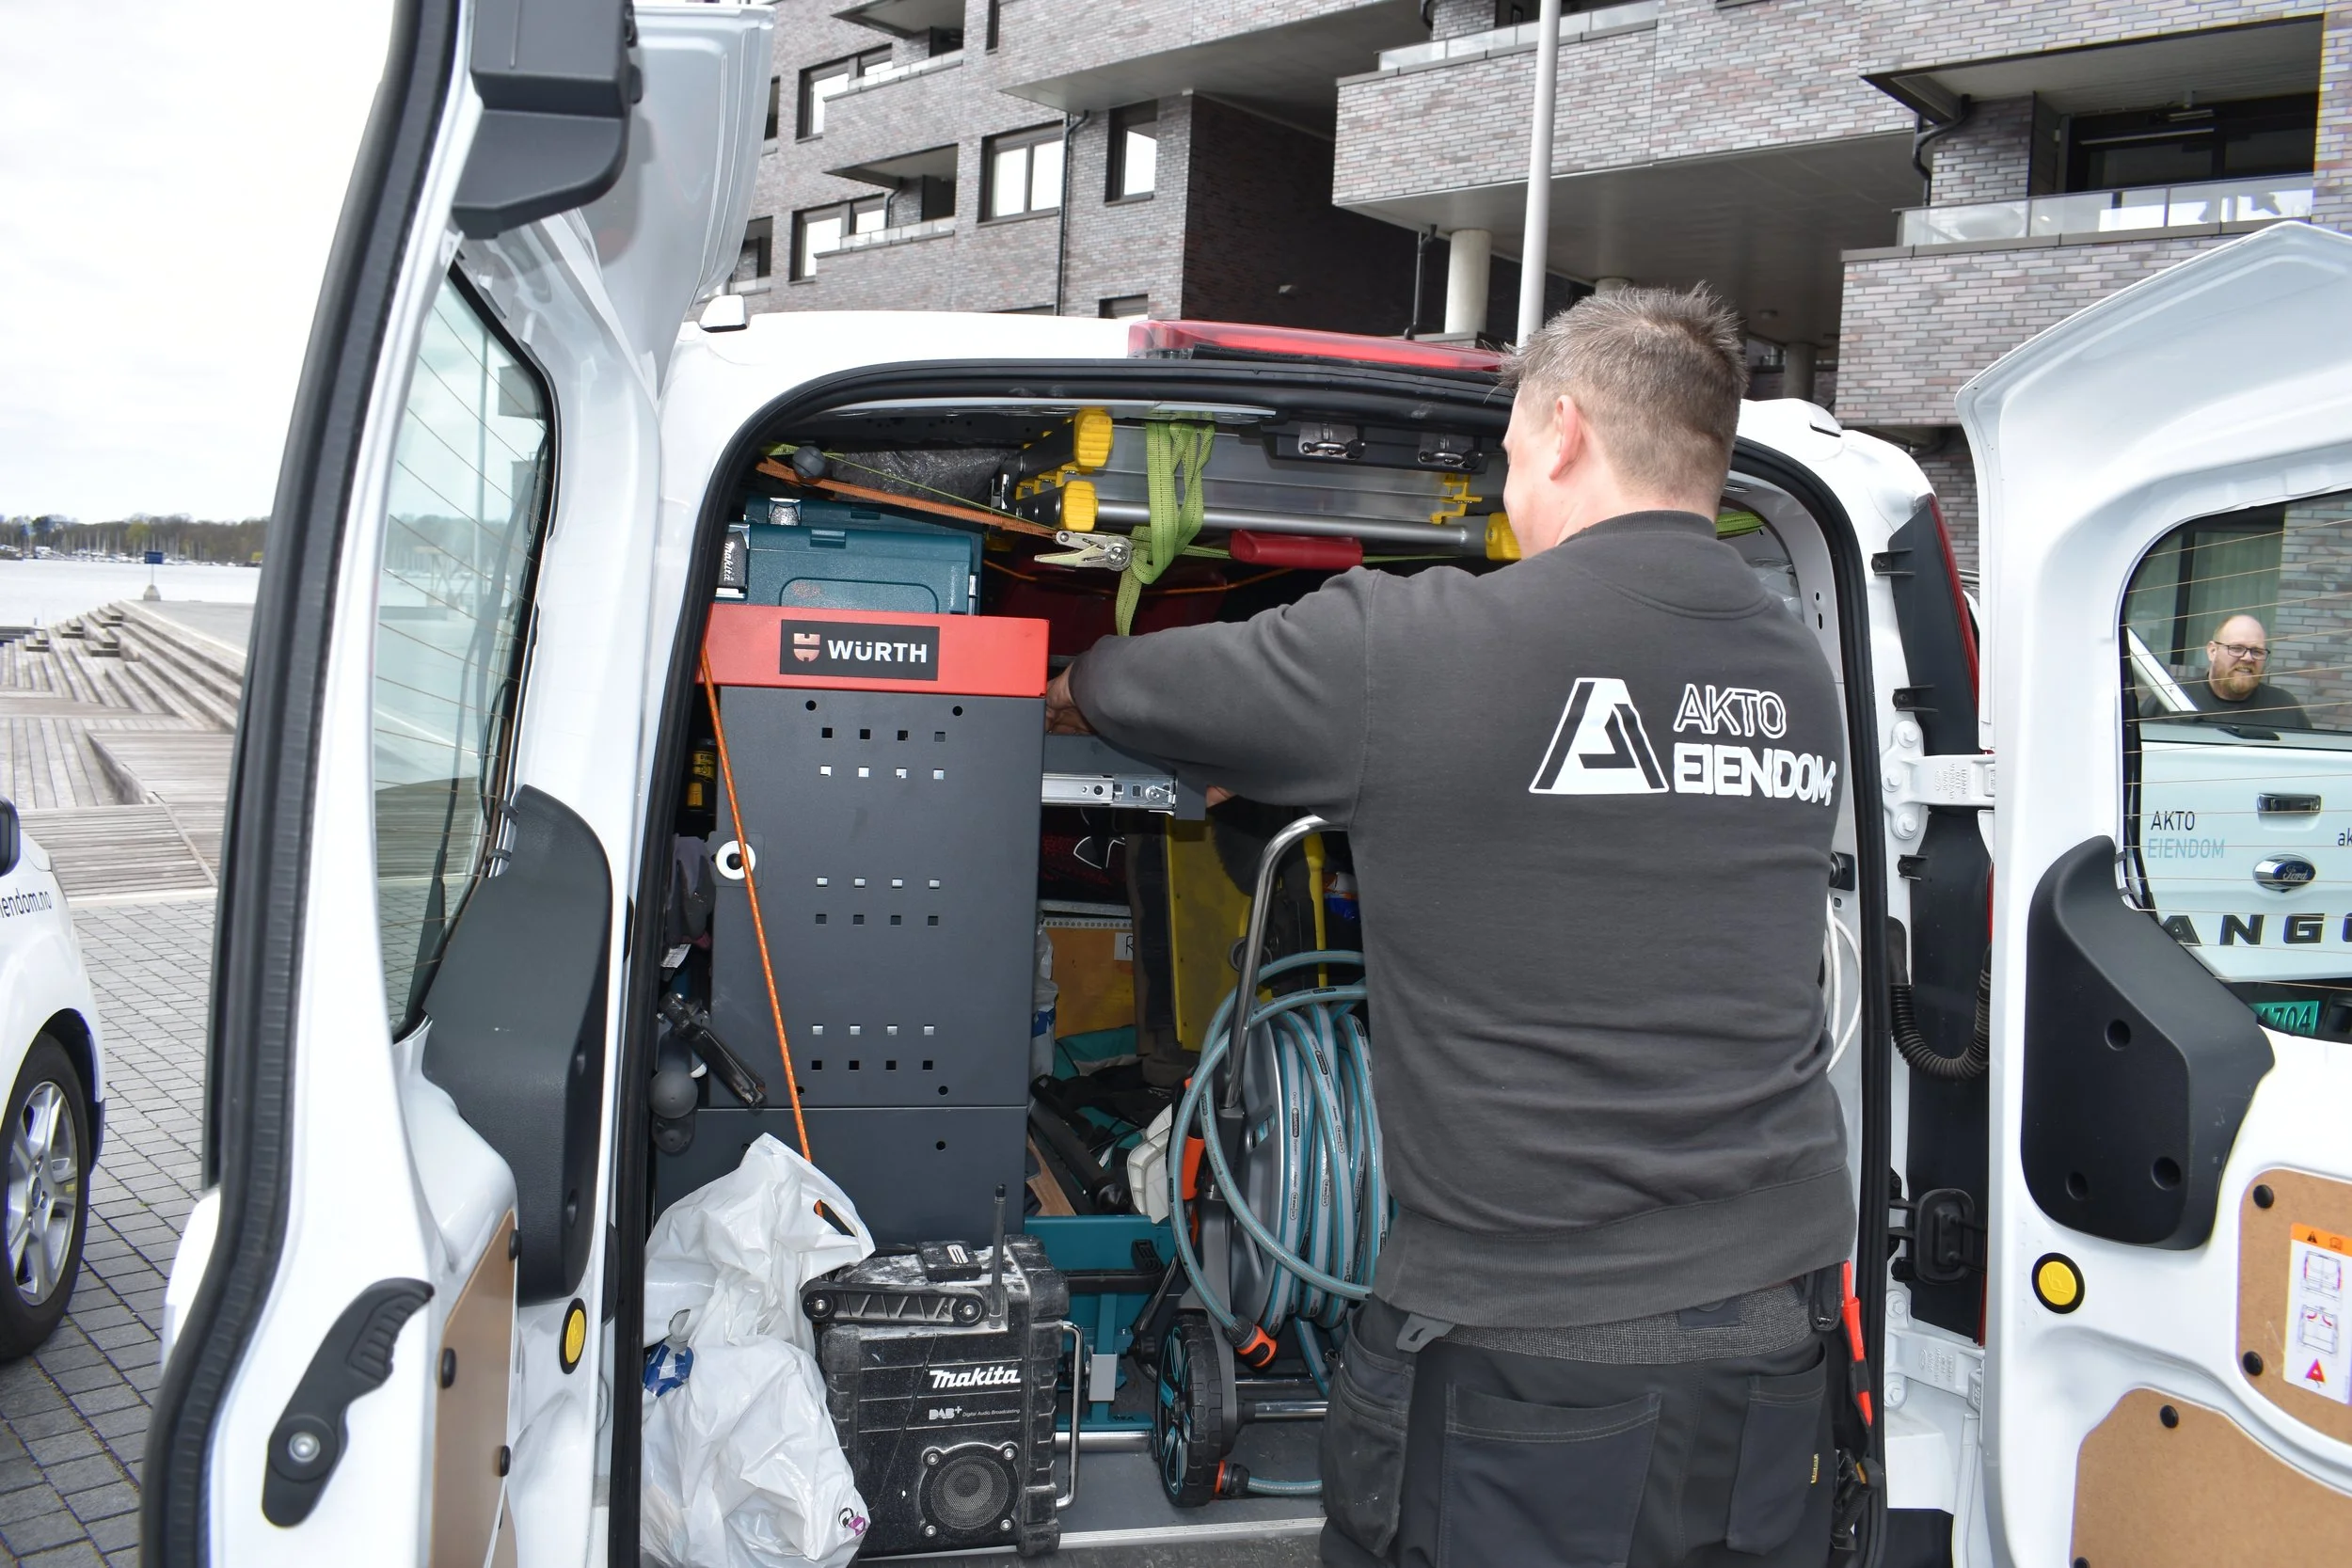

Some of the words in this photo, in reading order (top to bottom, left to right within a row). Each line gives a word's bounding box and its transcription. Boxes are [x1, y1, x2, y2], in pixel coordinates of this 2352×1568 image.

[827, 640, 928, 663] WÜRTH
[1673, 683, 1787, 739] AKTO
[1674, 742, 1836, 806] EIENDOM
[2151, 811, 2196, 831] AKTO
[2147, 837, 2225, 859] EIENDOM
